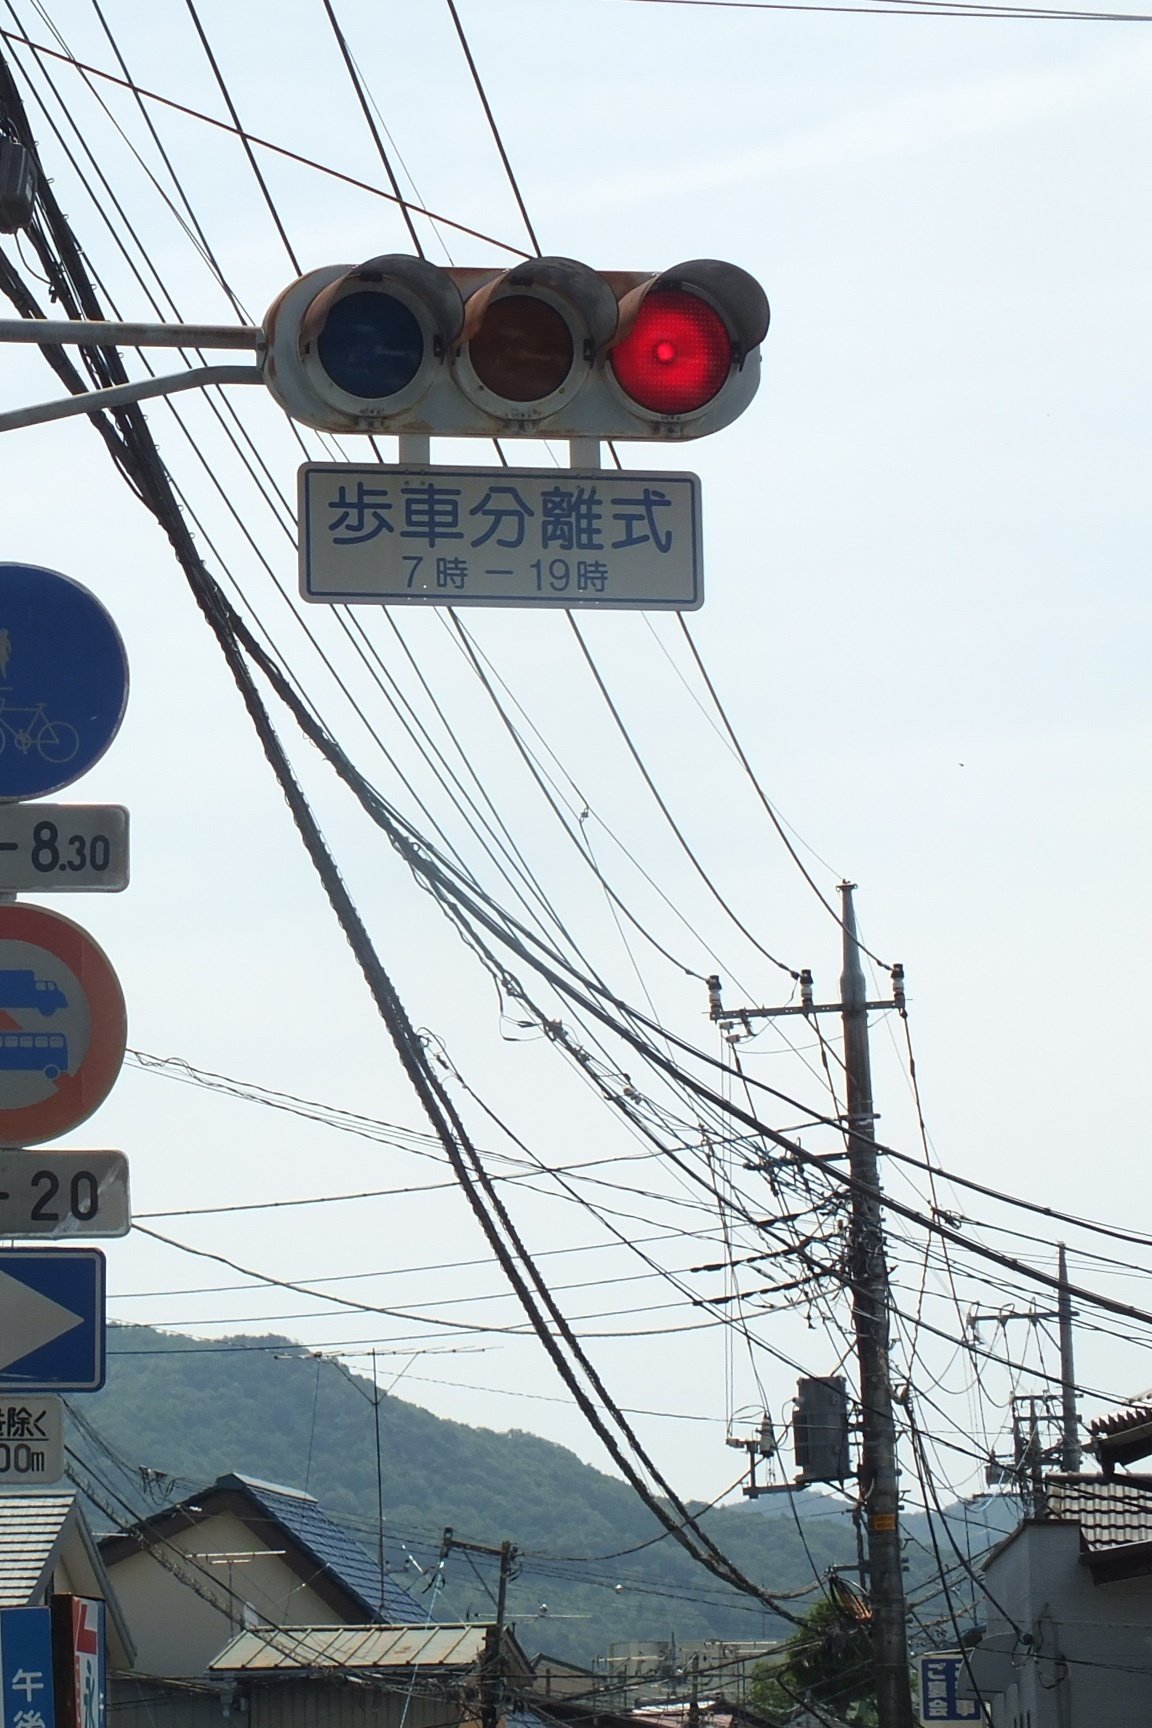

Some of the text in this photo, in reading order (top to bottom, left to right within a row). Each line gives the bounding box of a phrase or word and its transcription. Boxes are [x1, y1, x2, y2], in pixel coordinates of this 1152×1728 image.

[327, 481, 673, 554] 歩車分離式
